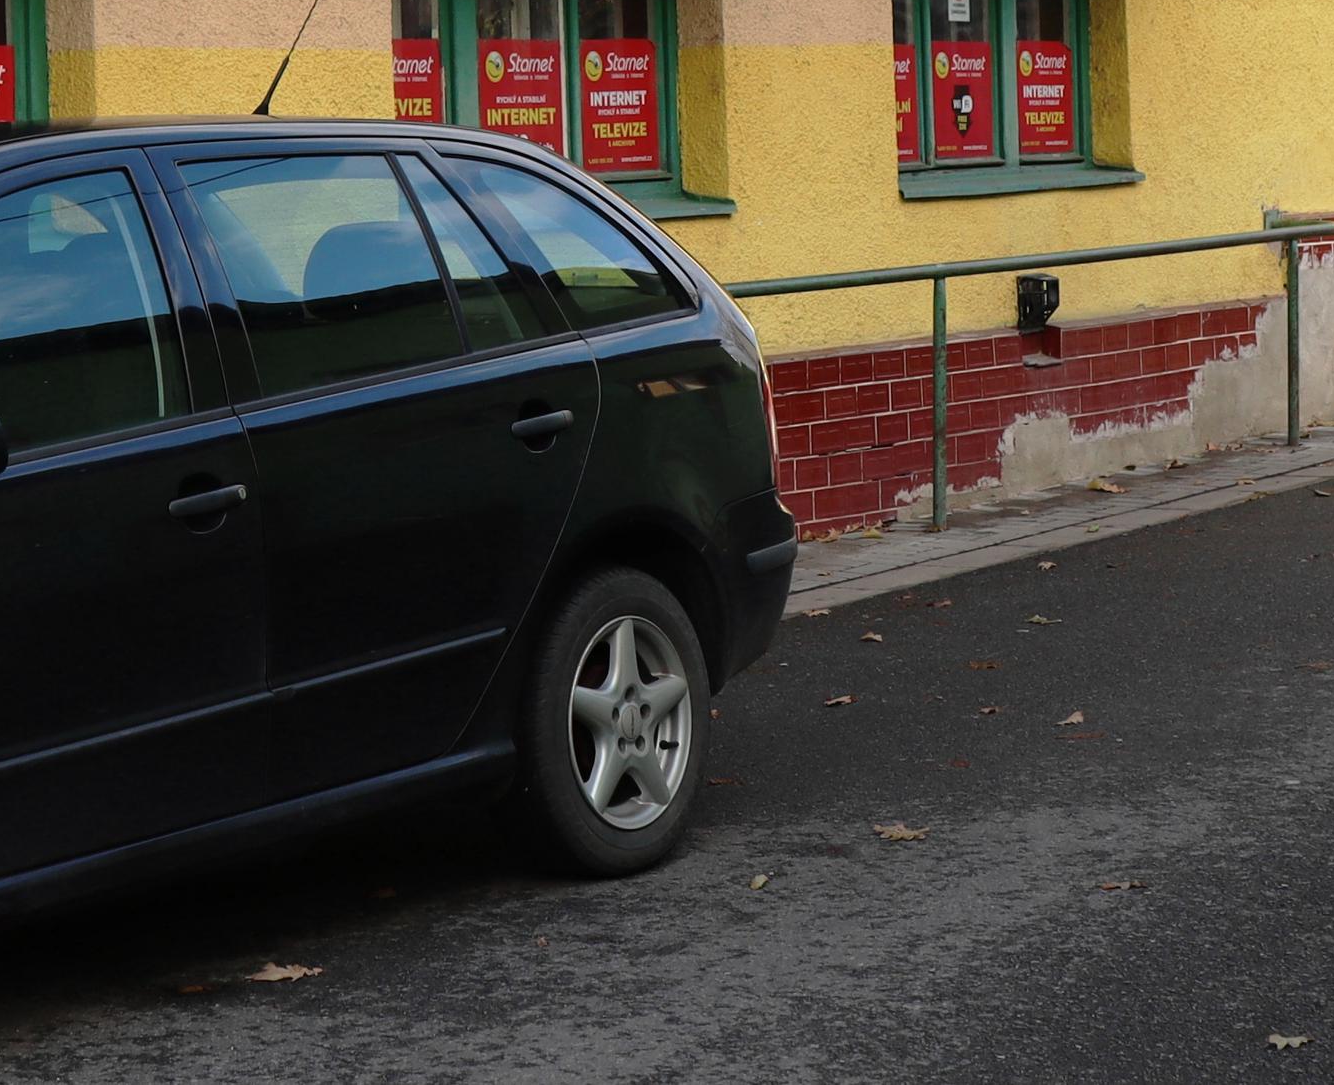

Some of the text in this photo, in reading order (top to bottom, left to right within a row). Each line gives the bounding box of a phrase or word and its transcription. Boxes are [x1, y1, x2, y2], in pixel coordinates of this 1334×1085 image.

[393, 56, 434, 74] tarnet
[507, 53, 555, 73] Starnet
[605, 52, 649, 72] Starnet
[951, 54, 986, 71] Starnet
[1034, 52, 1067, 69] Starnet
[590, 90, 647, 107] INTERNET
[1023, 85, 1065, 98] INTERNET
[487, 108, 556, 126] INTERNET
[1025, 112, 1065, 125] TELEVIZE
[592, 122, 648, 139] TELEVIZE
